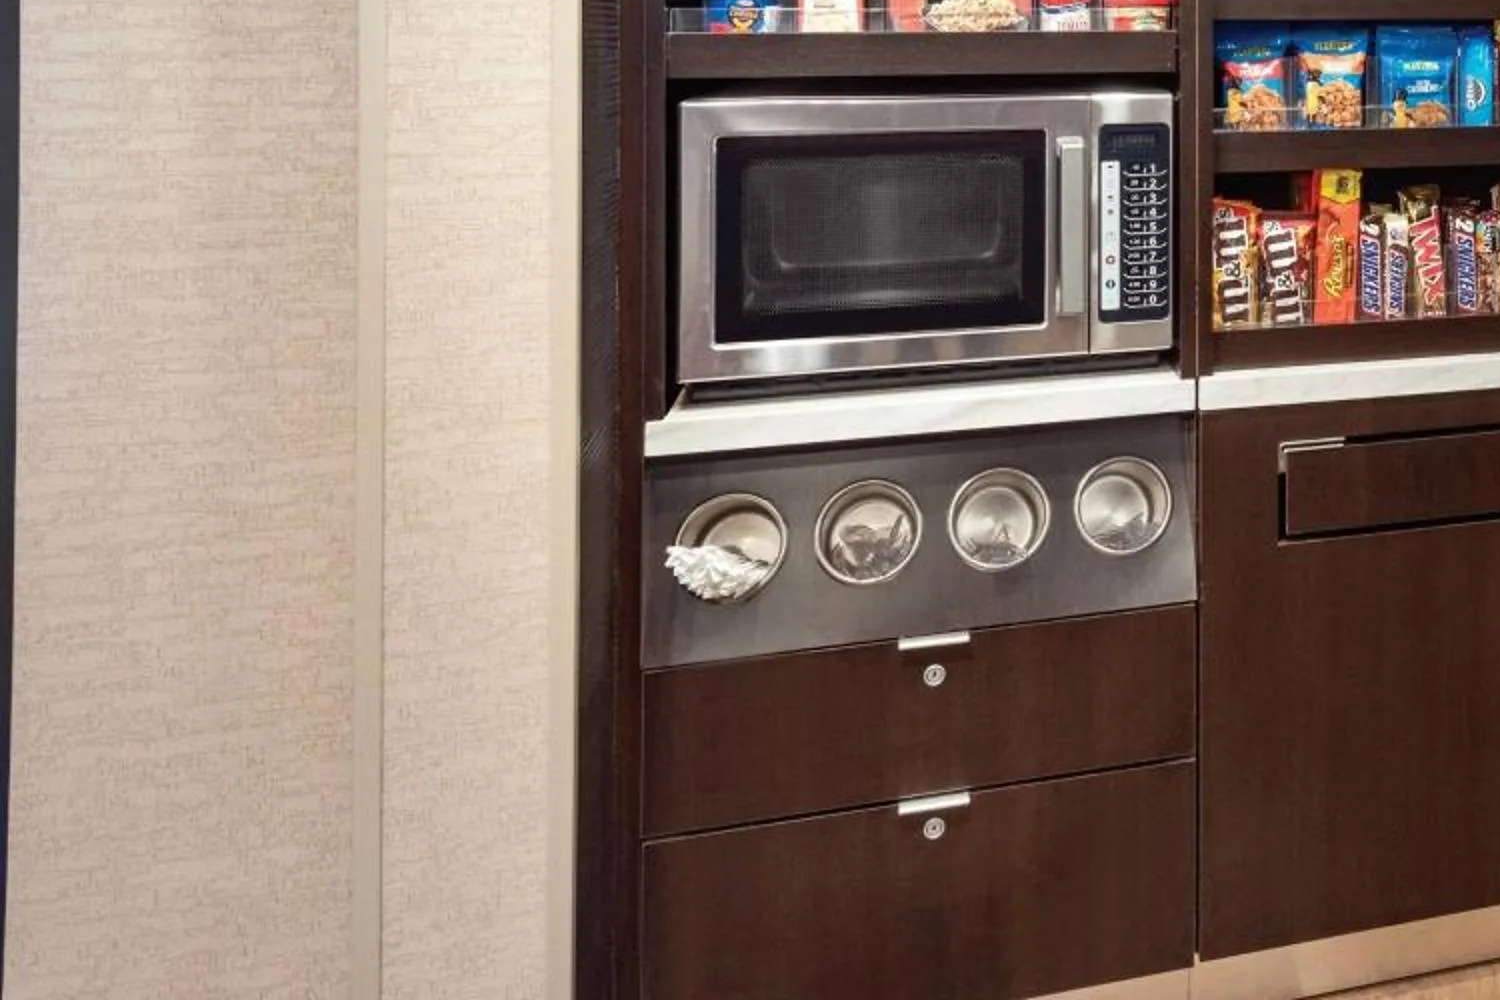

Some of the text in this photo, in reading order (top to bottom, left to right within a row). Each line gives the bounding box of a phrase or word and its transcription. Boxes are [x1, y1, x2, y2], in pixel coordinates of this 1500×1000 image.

[1361, 238, 1380, 313] SNICKERS
[1408, 205, 1445, 306] TWIX
[1457, 235, 1476, 310] SNICKERS
